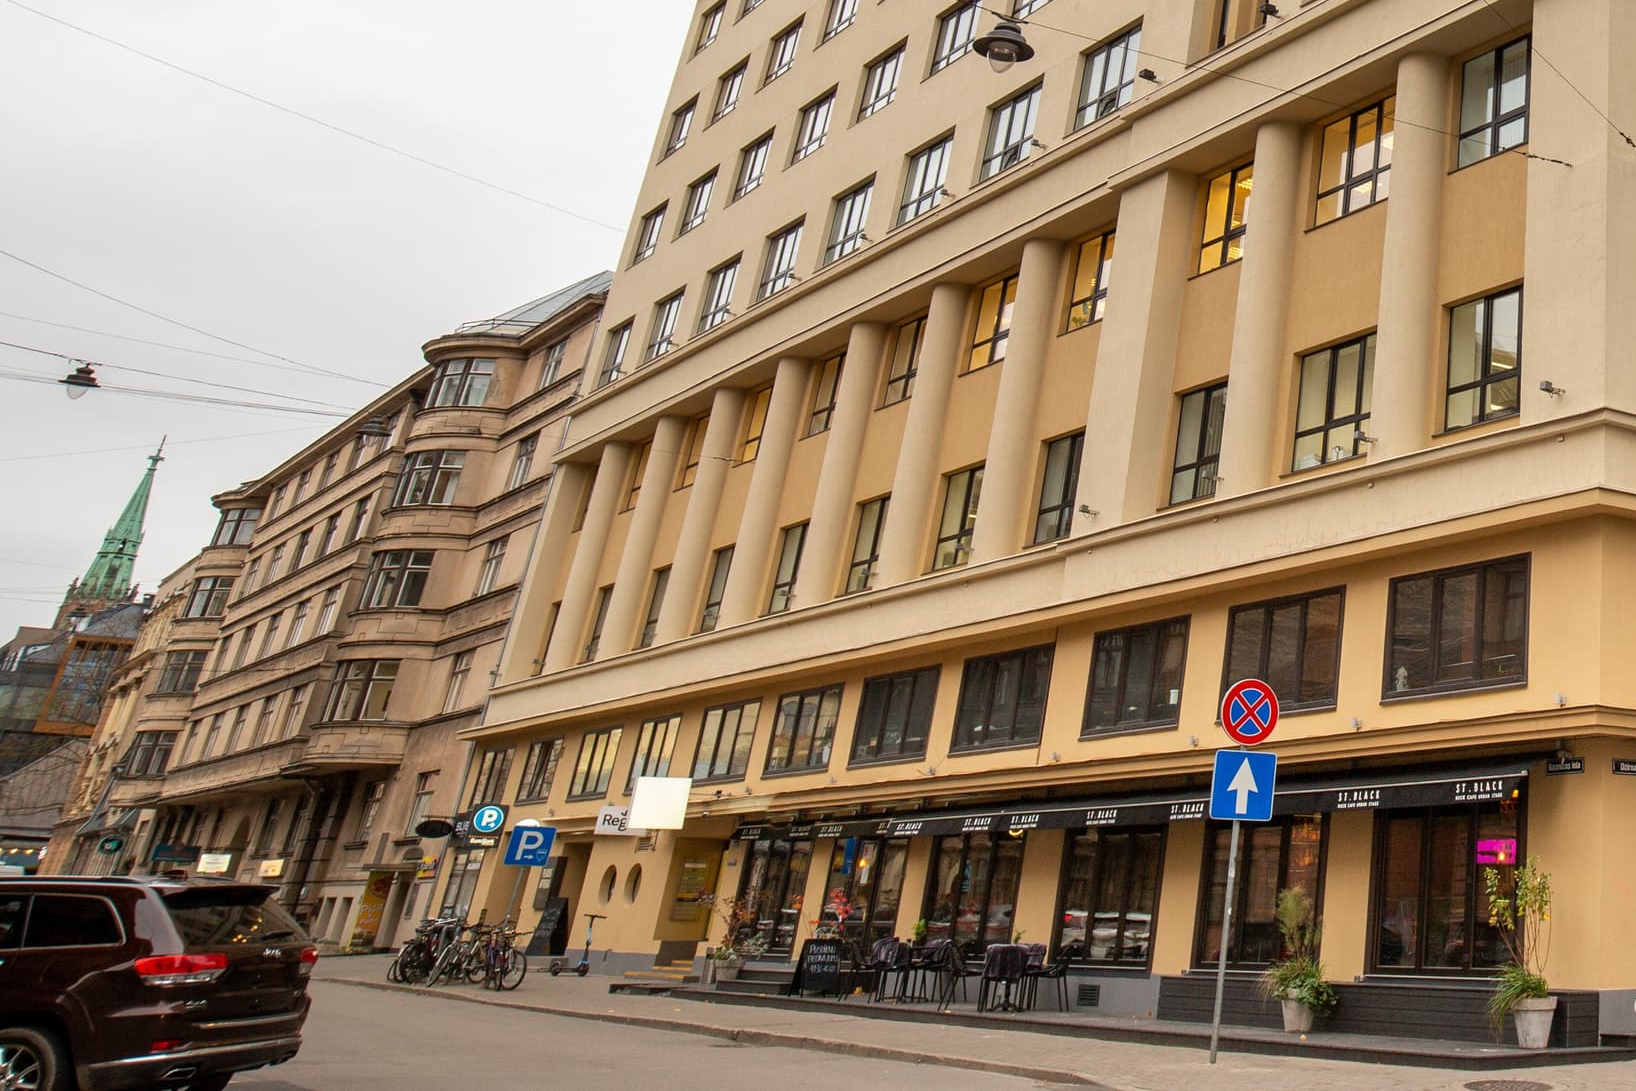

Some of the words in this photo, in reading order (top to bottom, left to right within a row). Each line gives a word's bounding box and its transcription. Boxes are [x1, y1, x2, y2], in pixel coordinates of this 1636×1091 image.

[1456, 780, 1503, 793] ST.BLACK
[1338, 790, 1380, 802] ST.BLACK
[1086, 809, 1118, 820] ST.BLACK
[1170, 803, 1204, 814] ST.BLACK
[515, 831, 544, 861] P
